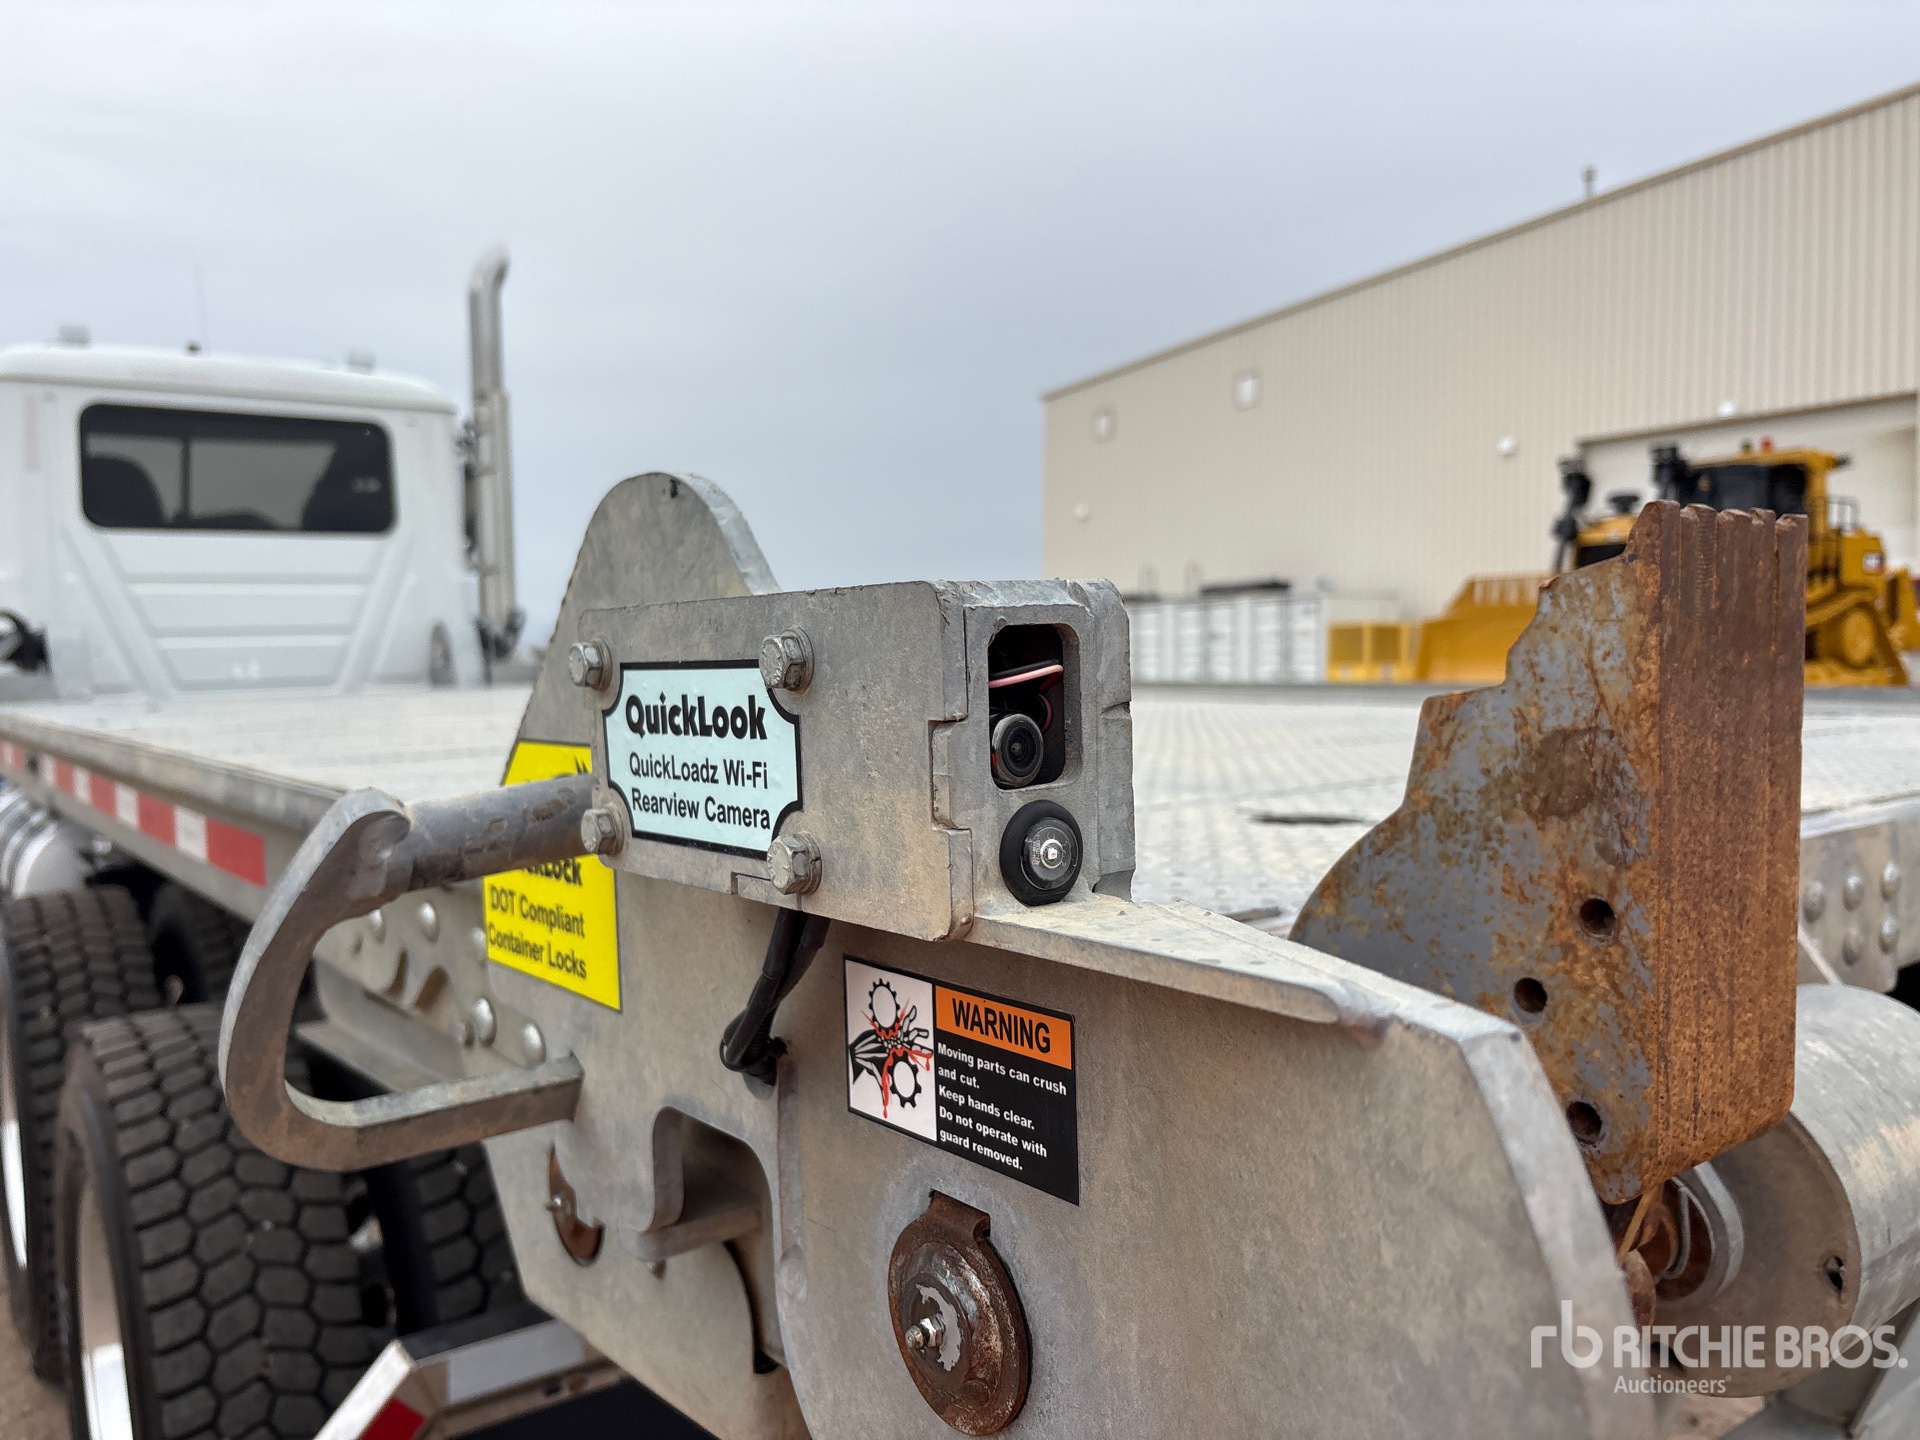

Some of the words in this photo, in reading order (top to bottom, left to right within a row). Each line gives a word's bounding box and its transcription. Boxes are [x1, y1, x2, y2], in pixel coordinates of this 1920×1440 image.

[625, 691, 768, 740] QuickLook
[629, 752, 719, 784] QuickLoadz
[723, 758, 768, 789] Wi-Fi
[631, 788, 699, 819] Rearview
[704, 796, 771, 830] Camera
[490, 885, 515, 915] DOT
[519, 895, 585, 938] Compliant
[488, 921, 544, 963] Container
[548, 942, 587, 980] Locks
[952, 998, 1051, 1054] WARNING
[938, 1042, 974, 1068] Moving
[977, 1053, 1006, 1076] parts
[1009, 1067, 1030, 1084] can
[1033, 1076, 1067, 1096] crush
[938, 1065, 956, 1081] and
[960, 1073, 980, 1089] cut.
[938, 1084, 965, 1105] Keep
[968, 1093, 1000, 1117] hands
[1003, 1109, 1035, 1130] clear.
[939, 1106, 953, 1121] Do
[956, 1115, 973, 1129] not
[976, 1121, 1018, 1146] operate
[1022, 1138, 1047, 1158] with
[940, 1129, 969, 1149] guard
[972, 1142, 1023, 1170] removed.
